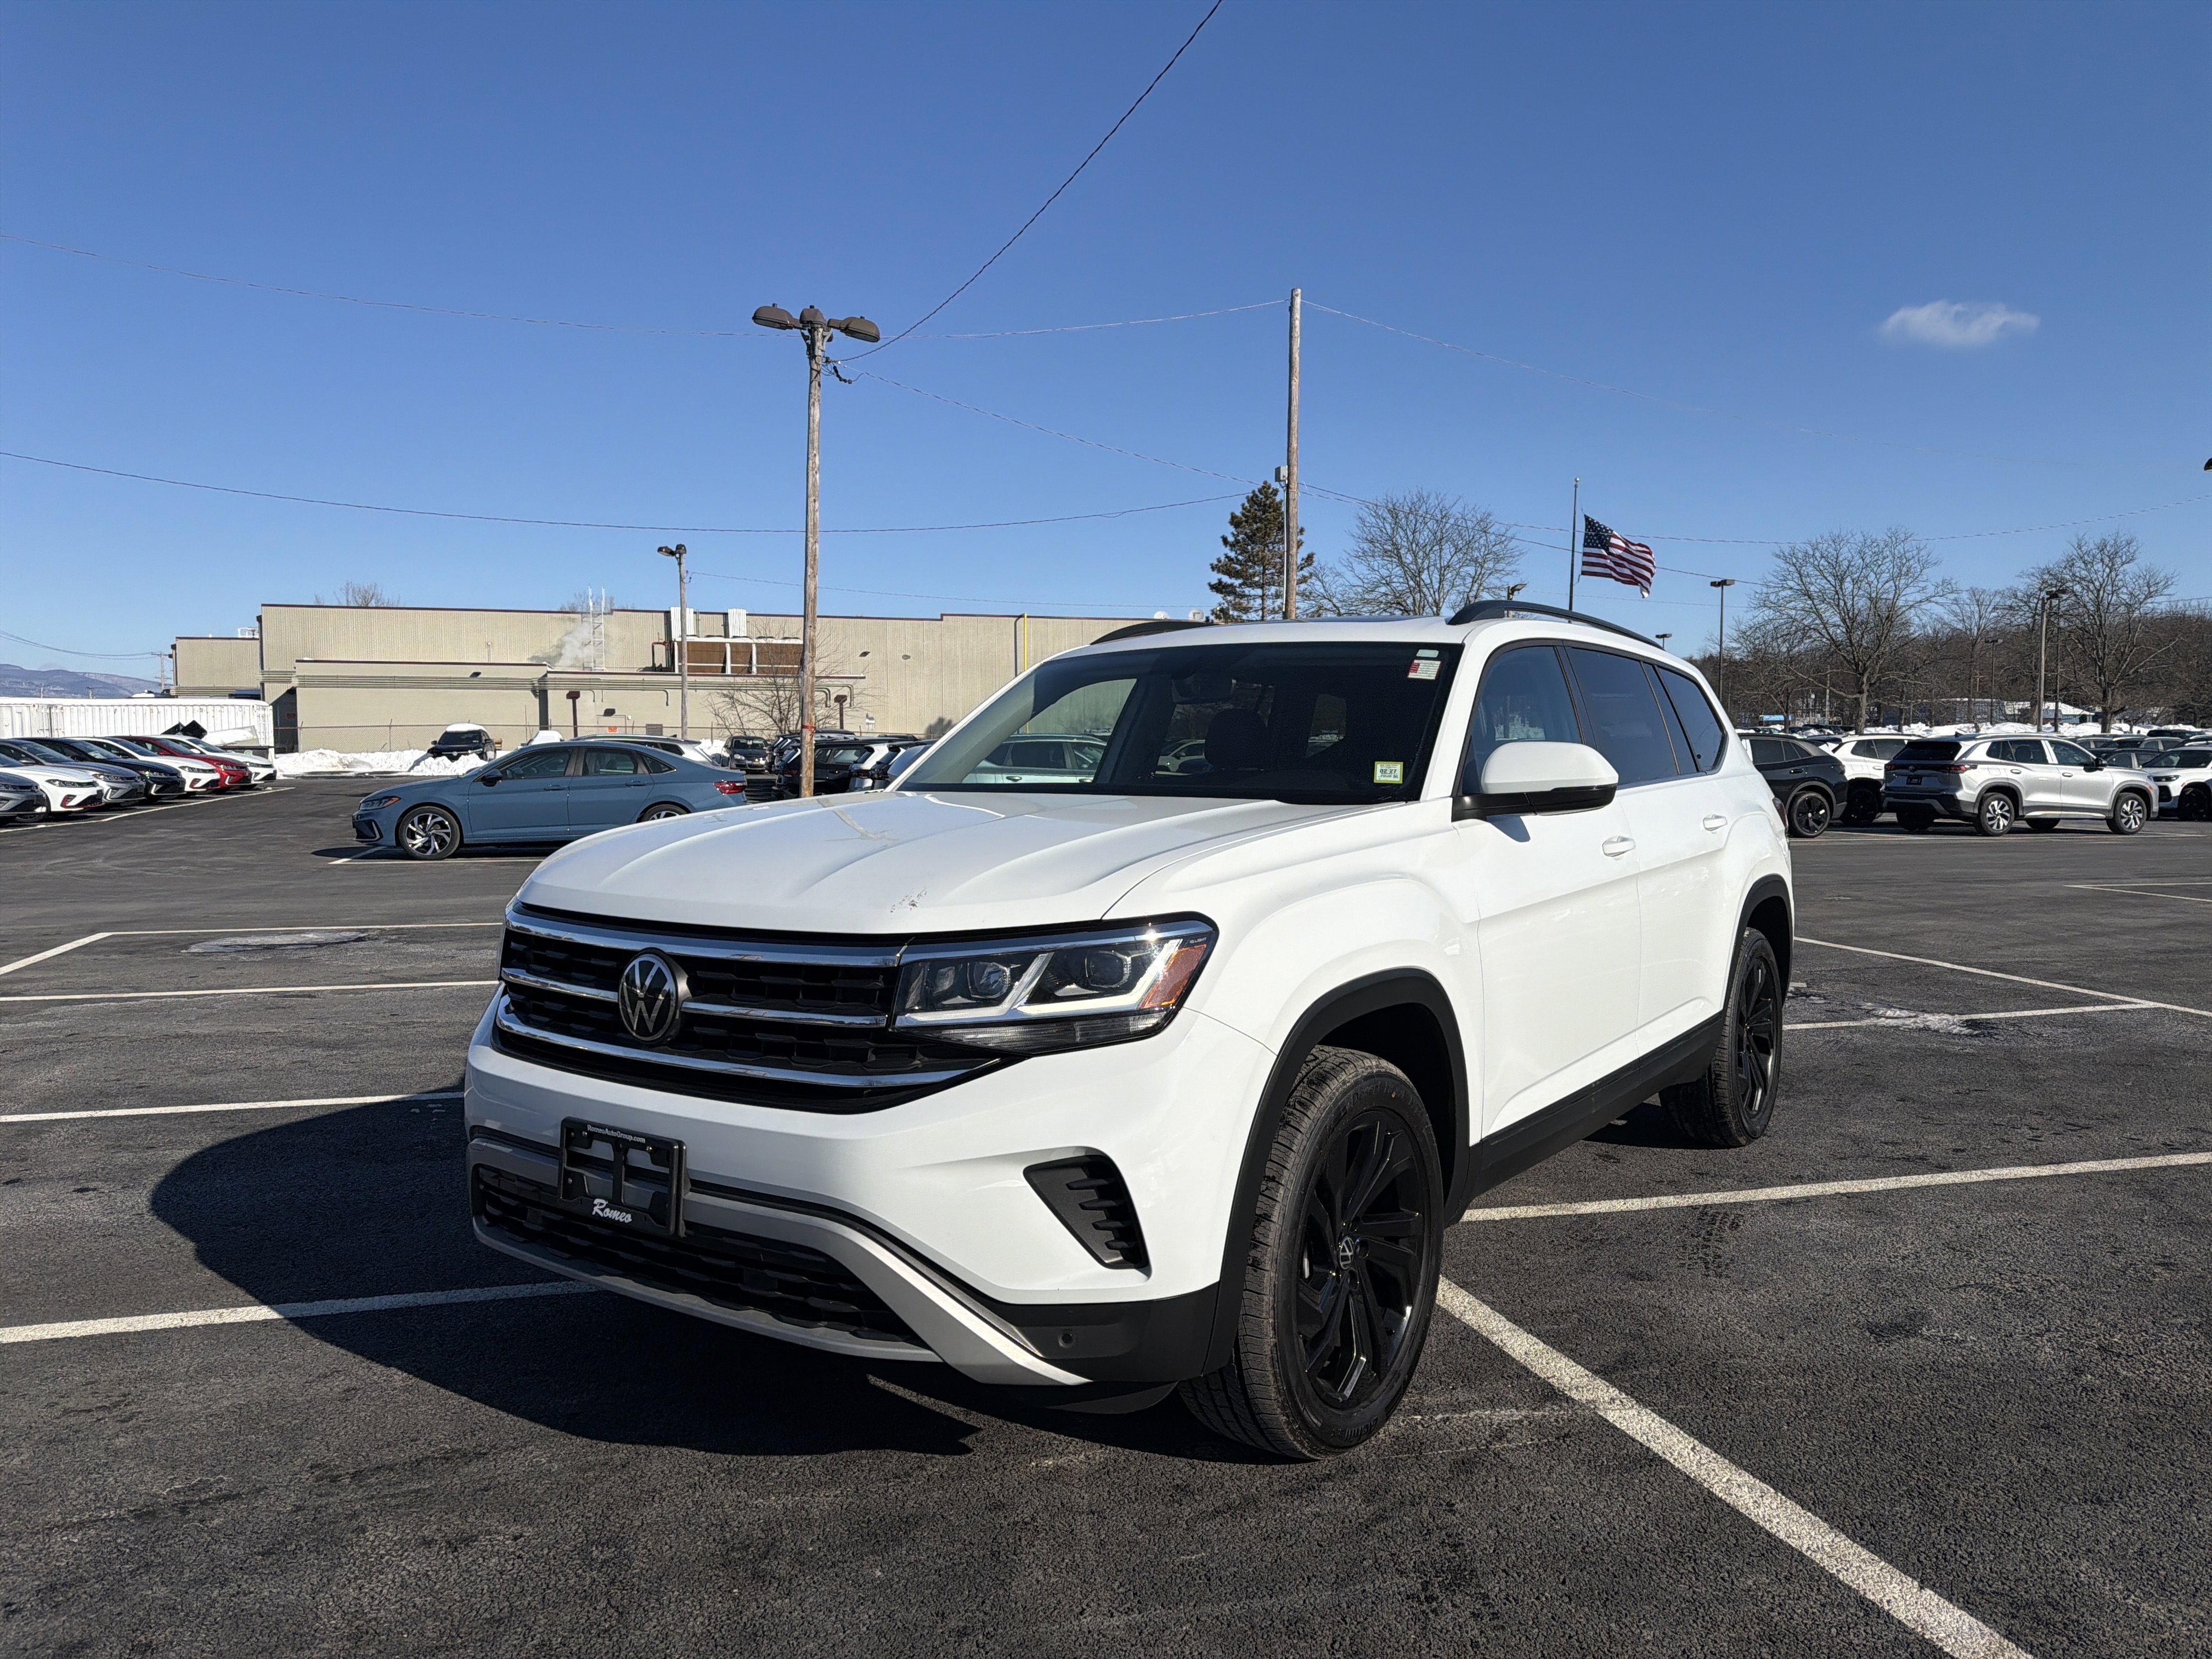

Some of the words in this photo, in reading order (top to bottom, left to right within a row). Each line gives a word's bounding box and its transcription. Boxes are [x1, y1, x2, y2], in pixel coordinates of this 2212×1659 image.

[620, 956, 675, 1039] VW
[587, 1124, 645, 1143] RomeoAutoGroup.com
[592, 1199, 633, 1224] Romeo
